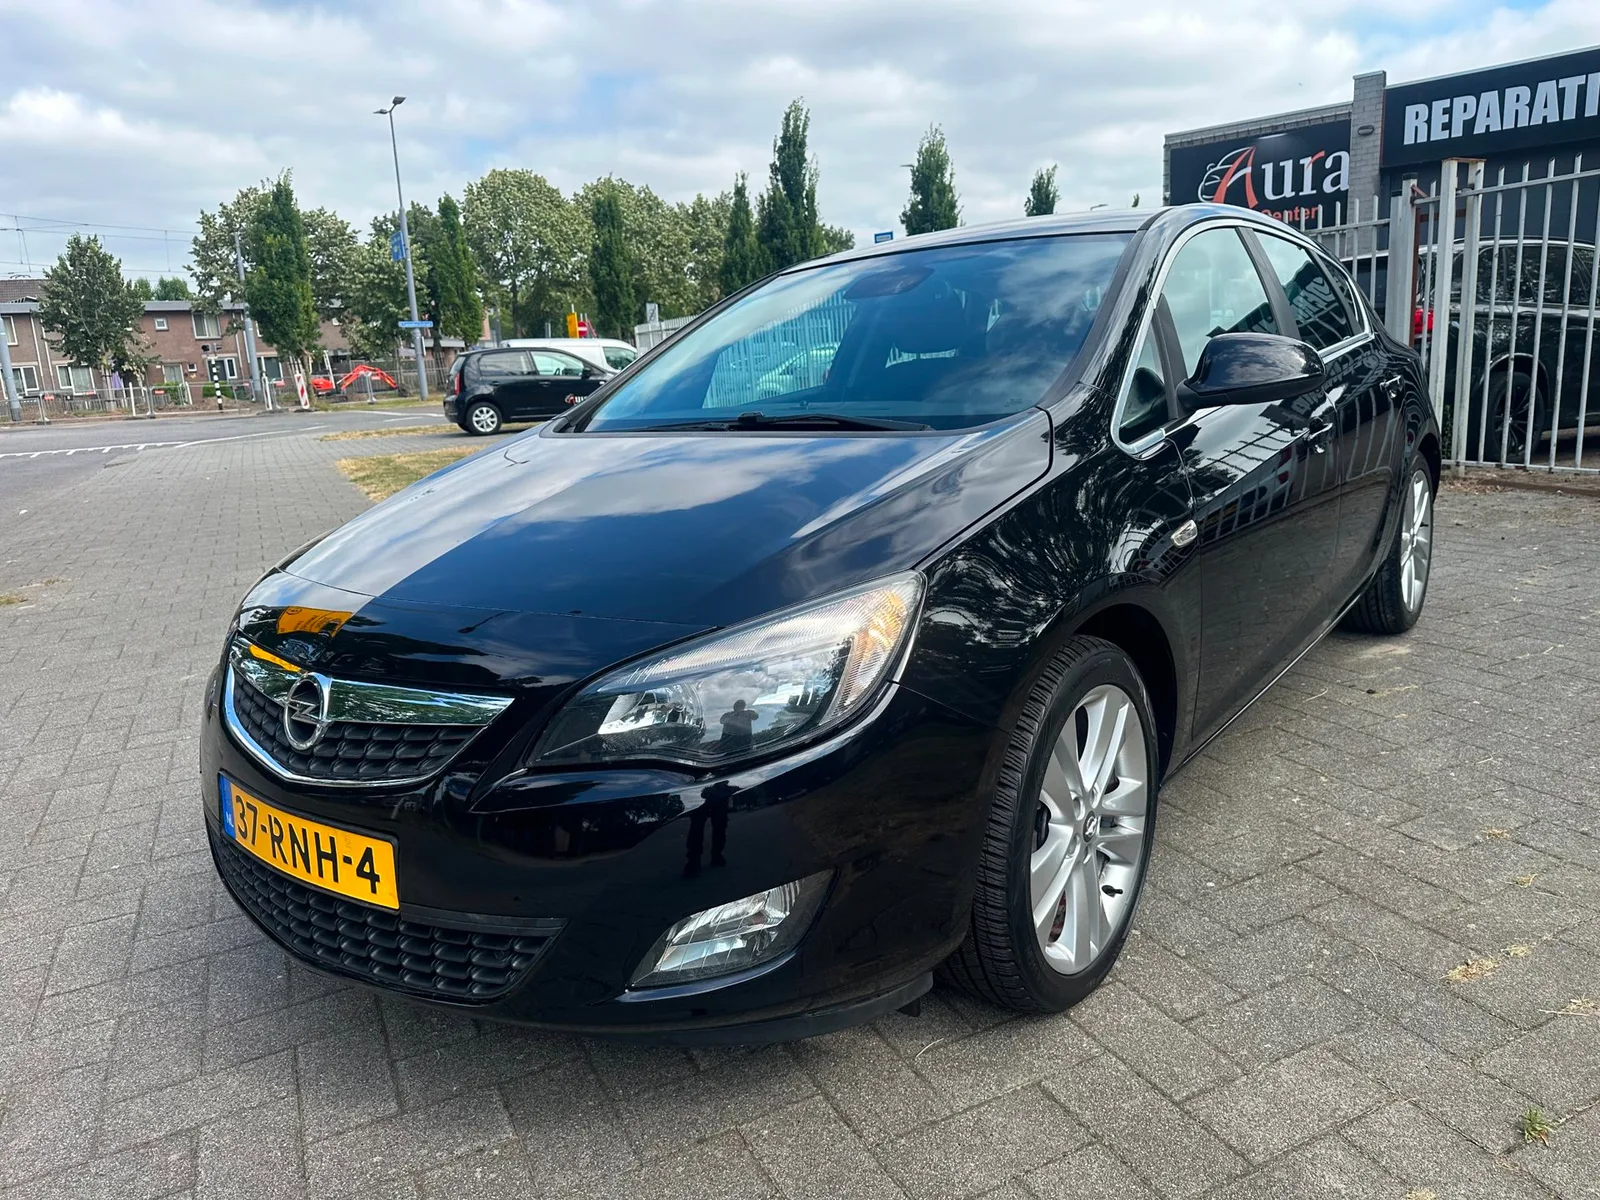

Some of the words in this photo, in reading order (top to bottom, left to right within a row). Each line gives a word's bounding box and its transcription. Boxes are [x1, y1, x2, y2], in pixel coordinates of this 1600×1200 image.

[1403, 72, 1600, 146] REPARATI
[1211, 146, 1350, 208] Aura
[235, 795, 380, 895] 37-RNH-4
